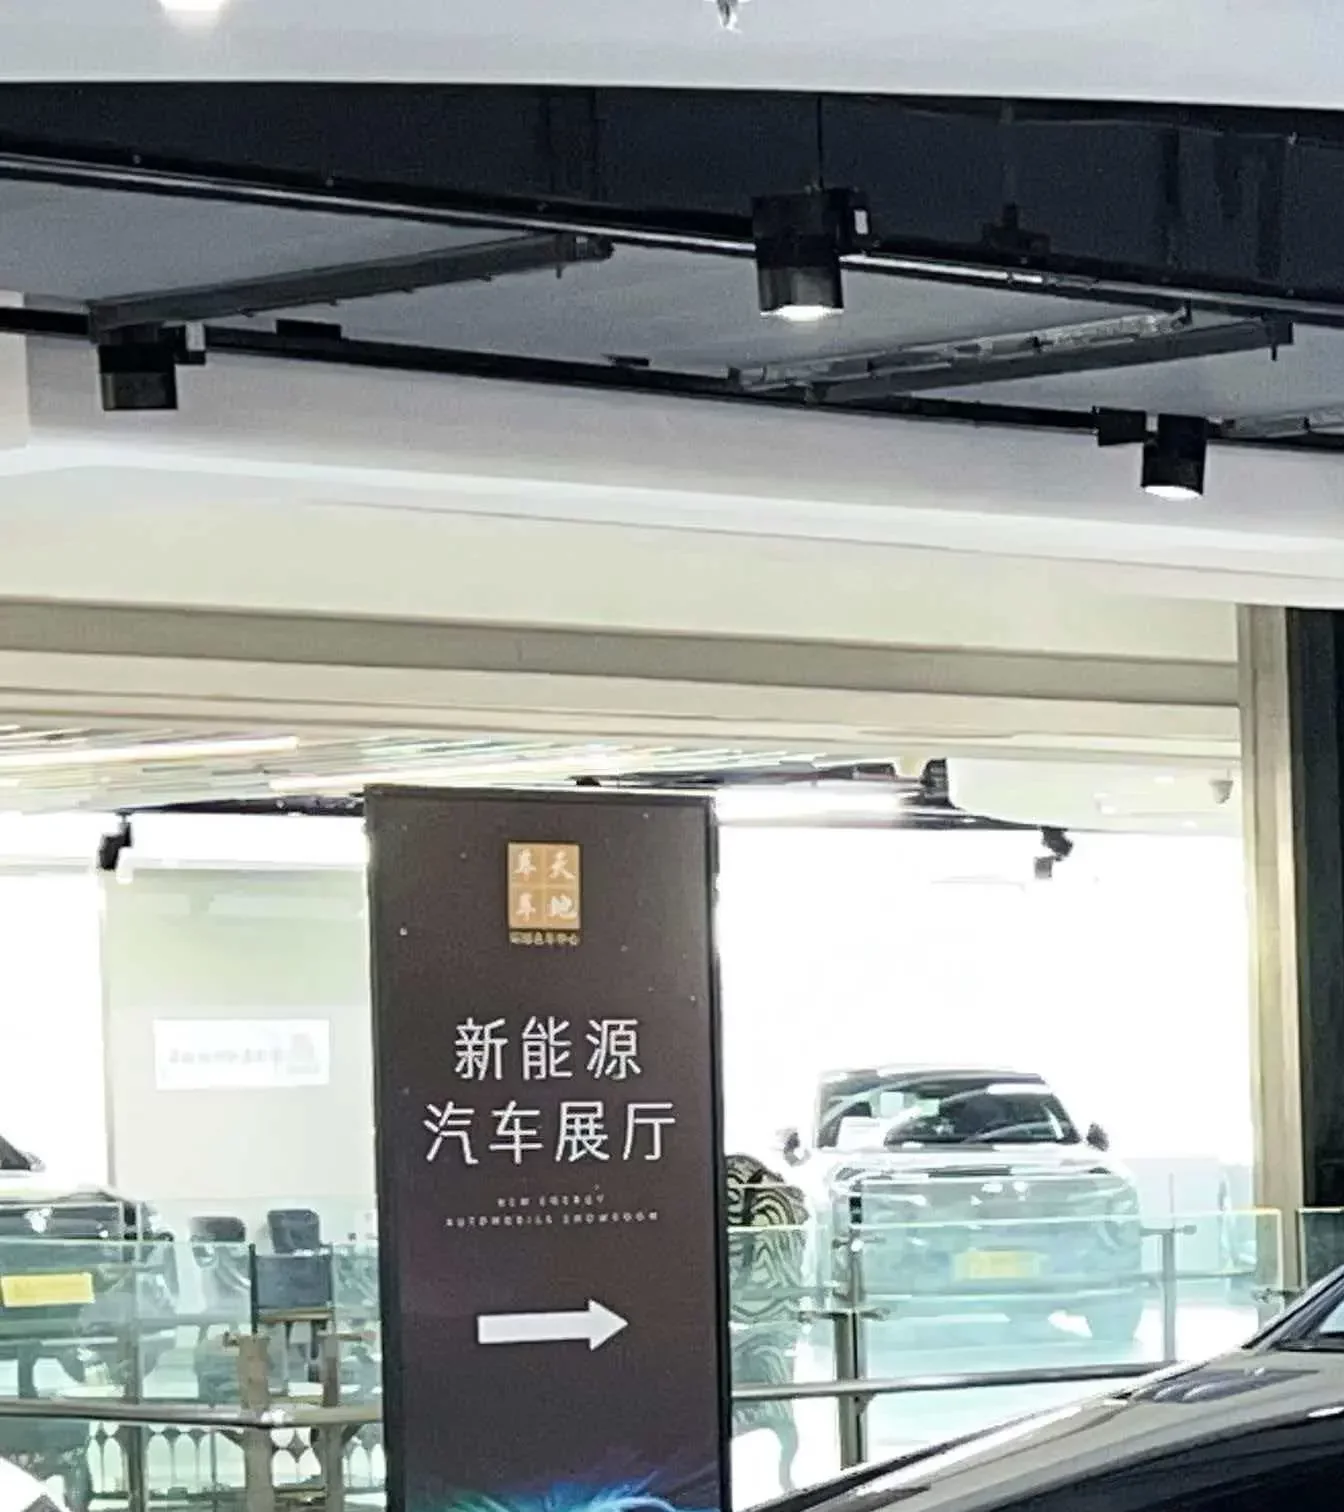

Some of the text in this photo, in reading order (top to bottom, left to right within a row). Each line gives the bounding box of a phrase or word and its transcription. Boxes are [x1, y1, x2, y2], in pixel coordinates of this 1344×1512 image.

[454, 1015, 642, 1081] 新能源
[422, 1100, 677, 1165] 汽车展厅
